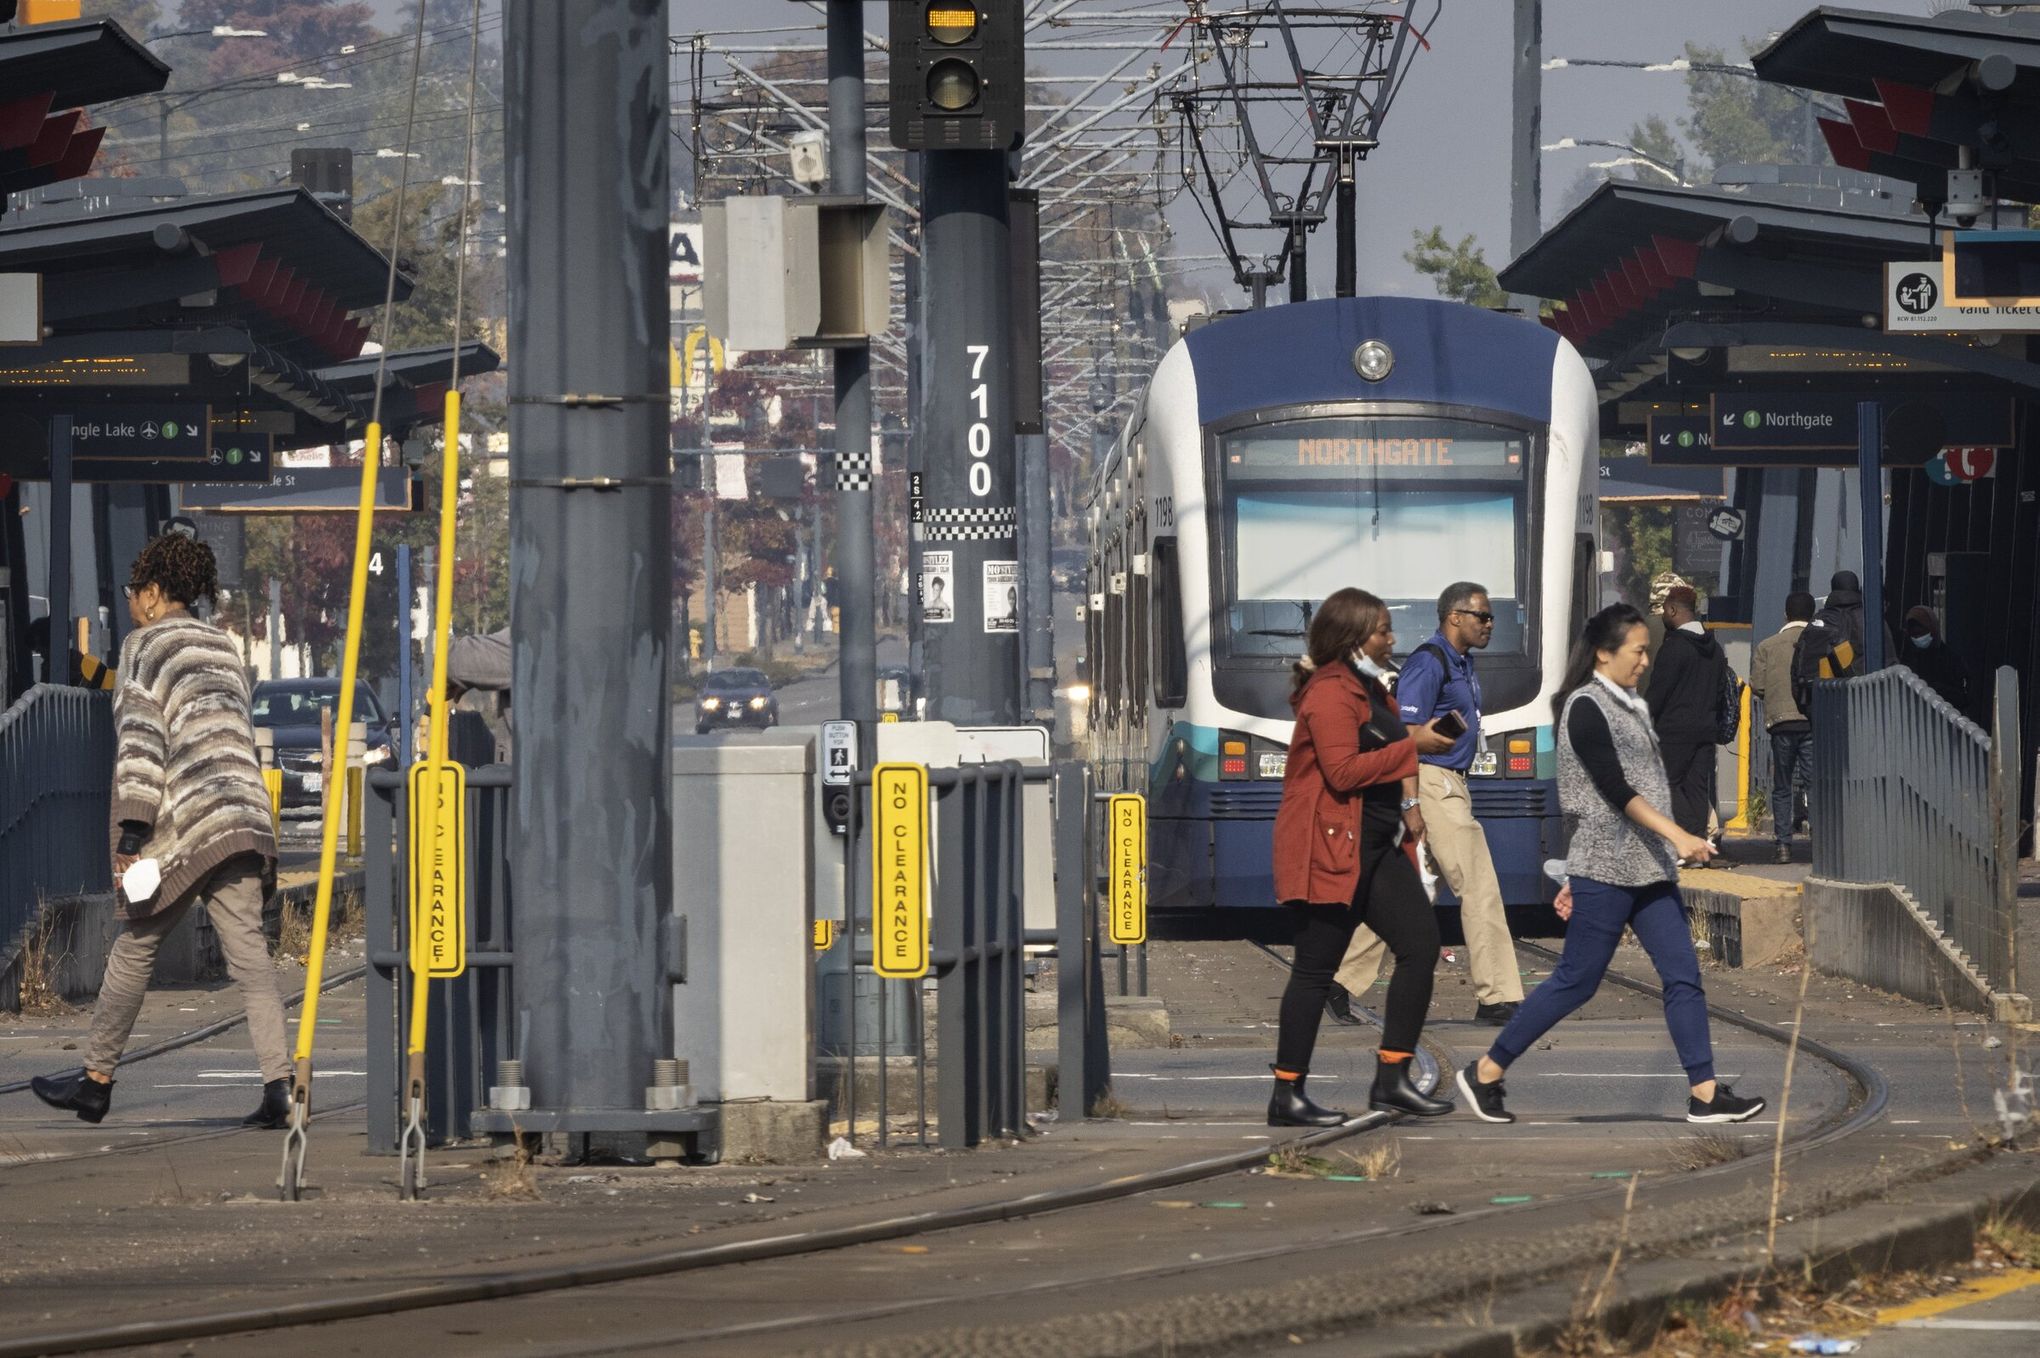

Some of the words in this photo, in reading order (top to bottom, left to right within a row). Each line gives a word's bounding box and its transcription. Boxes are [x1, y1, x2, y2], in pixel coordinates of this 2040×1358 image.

[72, 424, 100, 439] ngle
[106, 423, 135, 437] Lake
[966, 345, 991, 496] 7100
[1766, 412, 1833, 429] Northgate
[1298, 438, 1453, 465] NORTHGATE
[286, 476, 296, 486] St
[1600, 466, 1611, 477] St
[368, 552, 384, 576] 4
[893, 783, 907, 809] NO
[1123, 809, 1132, 827] NO
[431, 825, 444, 957] EARANCE
[893, 825, 908, 957] CLEARANCE
[1123, 838, 1132, 930] CLEARANCE
